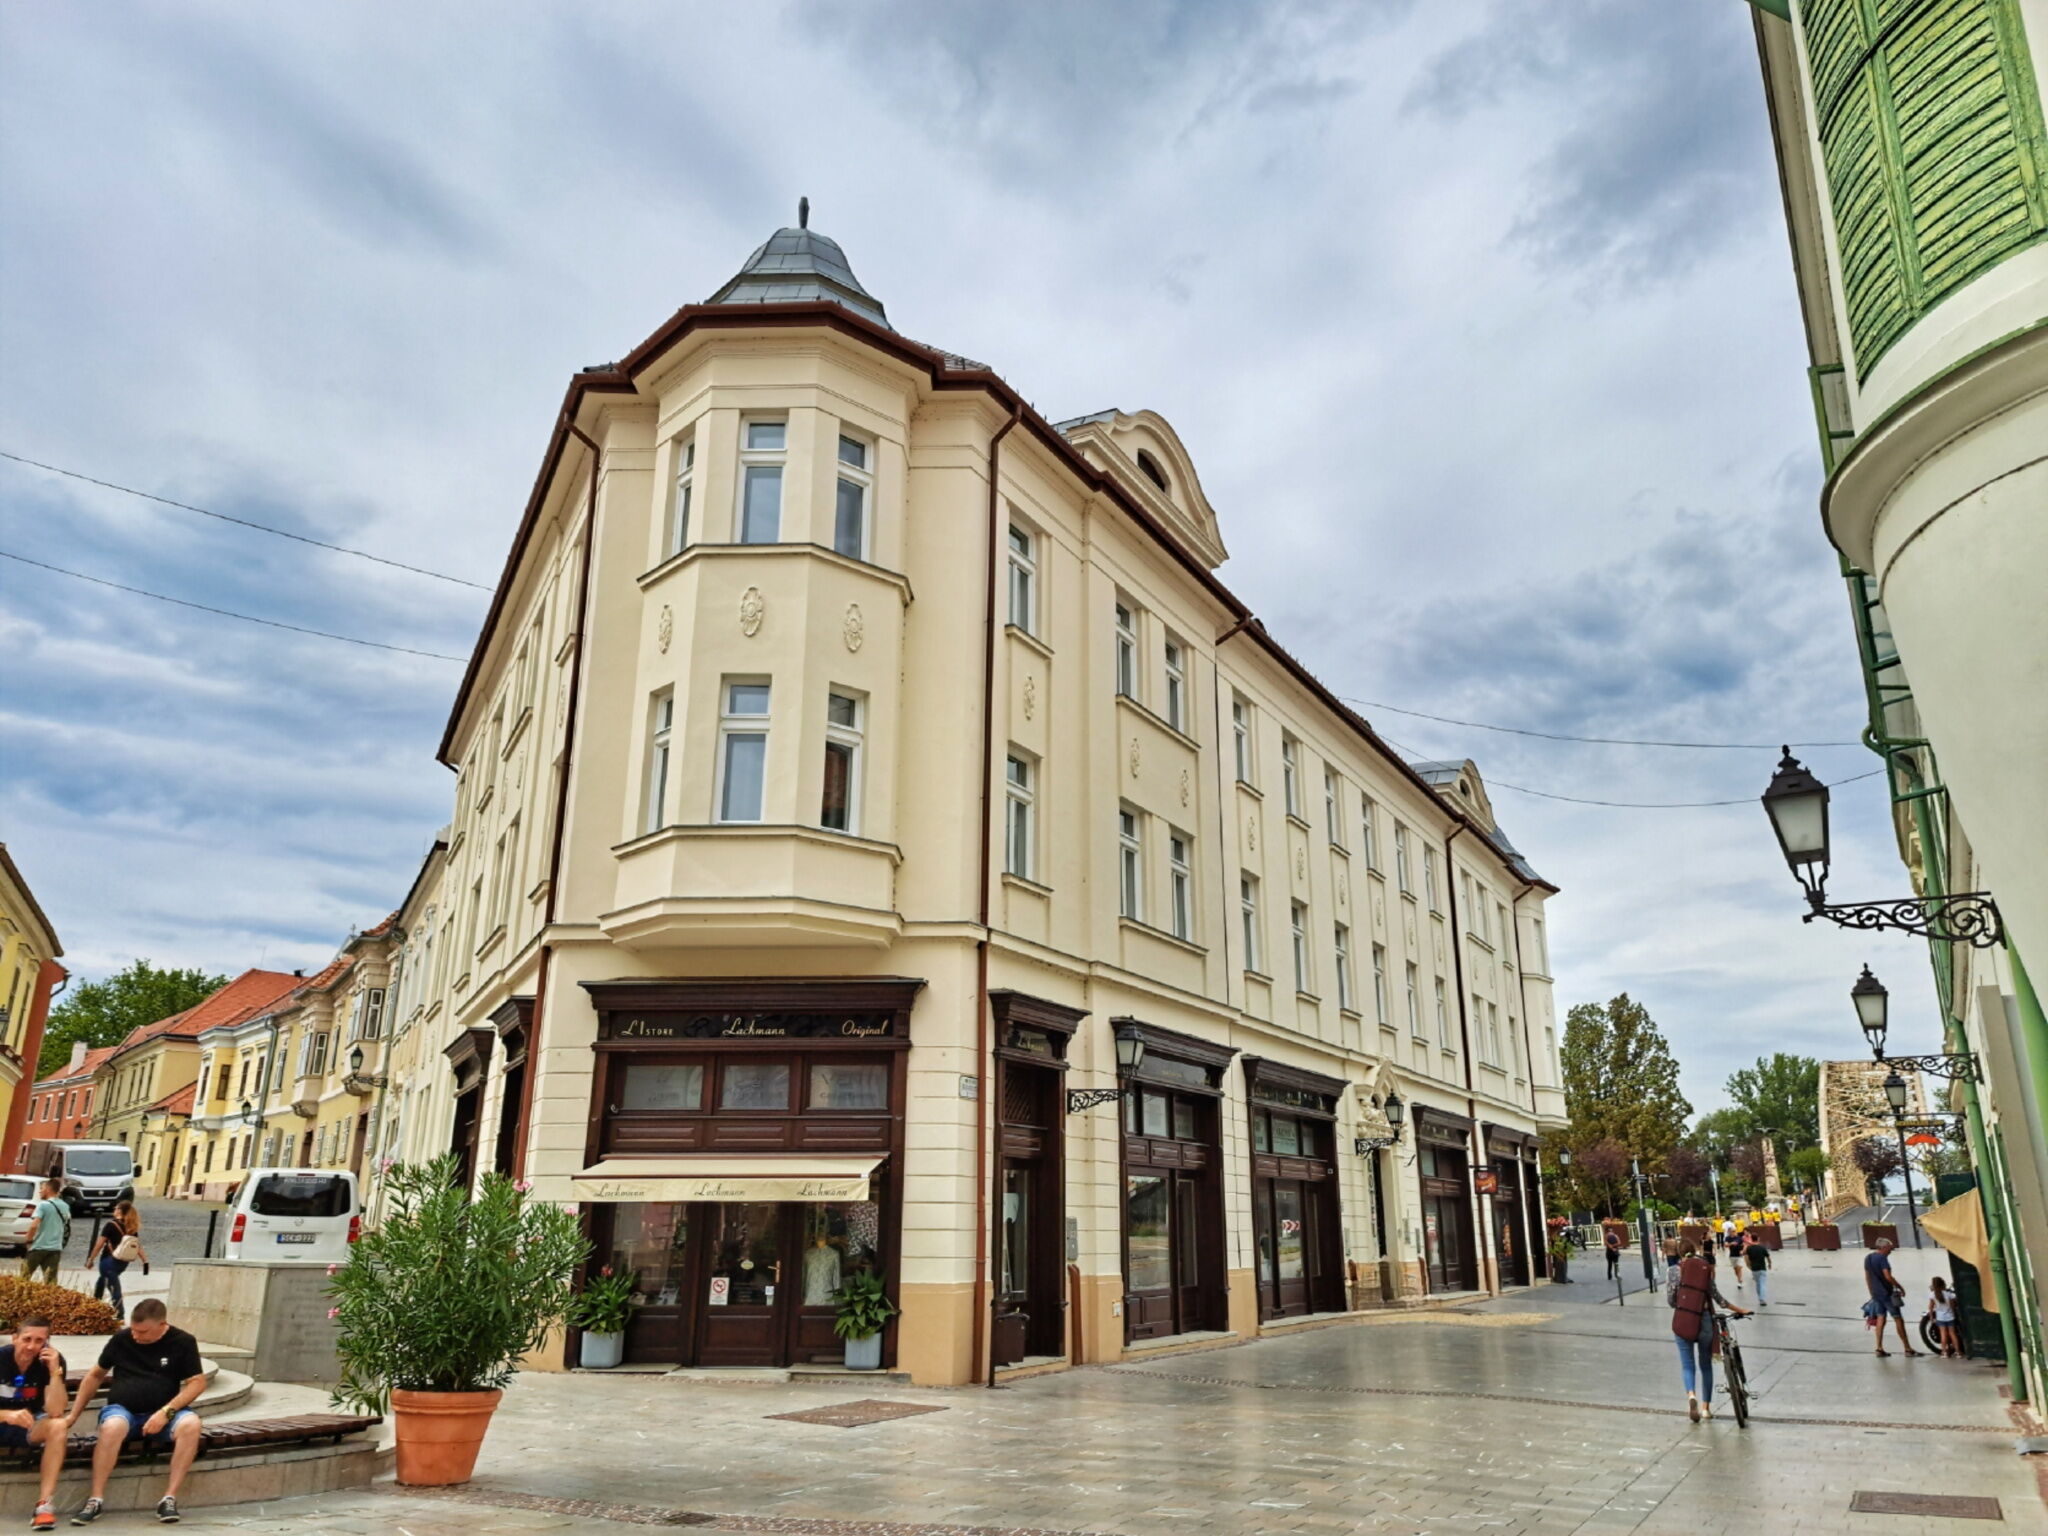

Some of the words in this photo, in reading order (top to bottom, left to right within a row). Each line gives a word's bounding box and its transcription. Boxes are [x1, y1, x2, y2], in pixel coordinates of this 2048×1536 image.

[721, 1017, 785, 1036] Lachmann
[842, 1019, 889, 1038] Original
[796, 1182, 848, 1197] Lachmann
